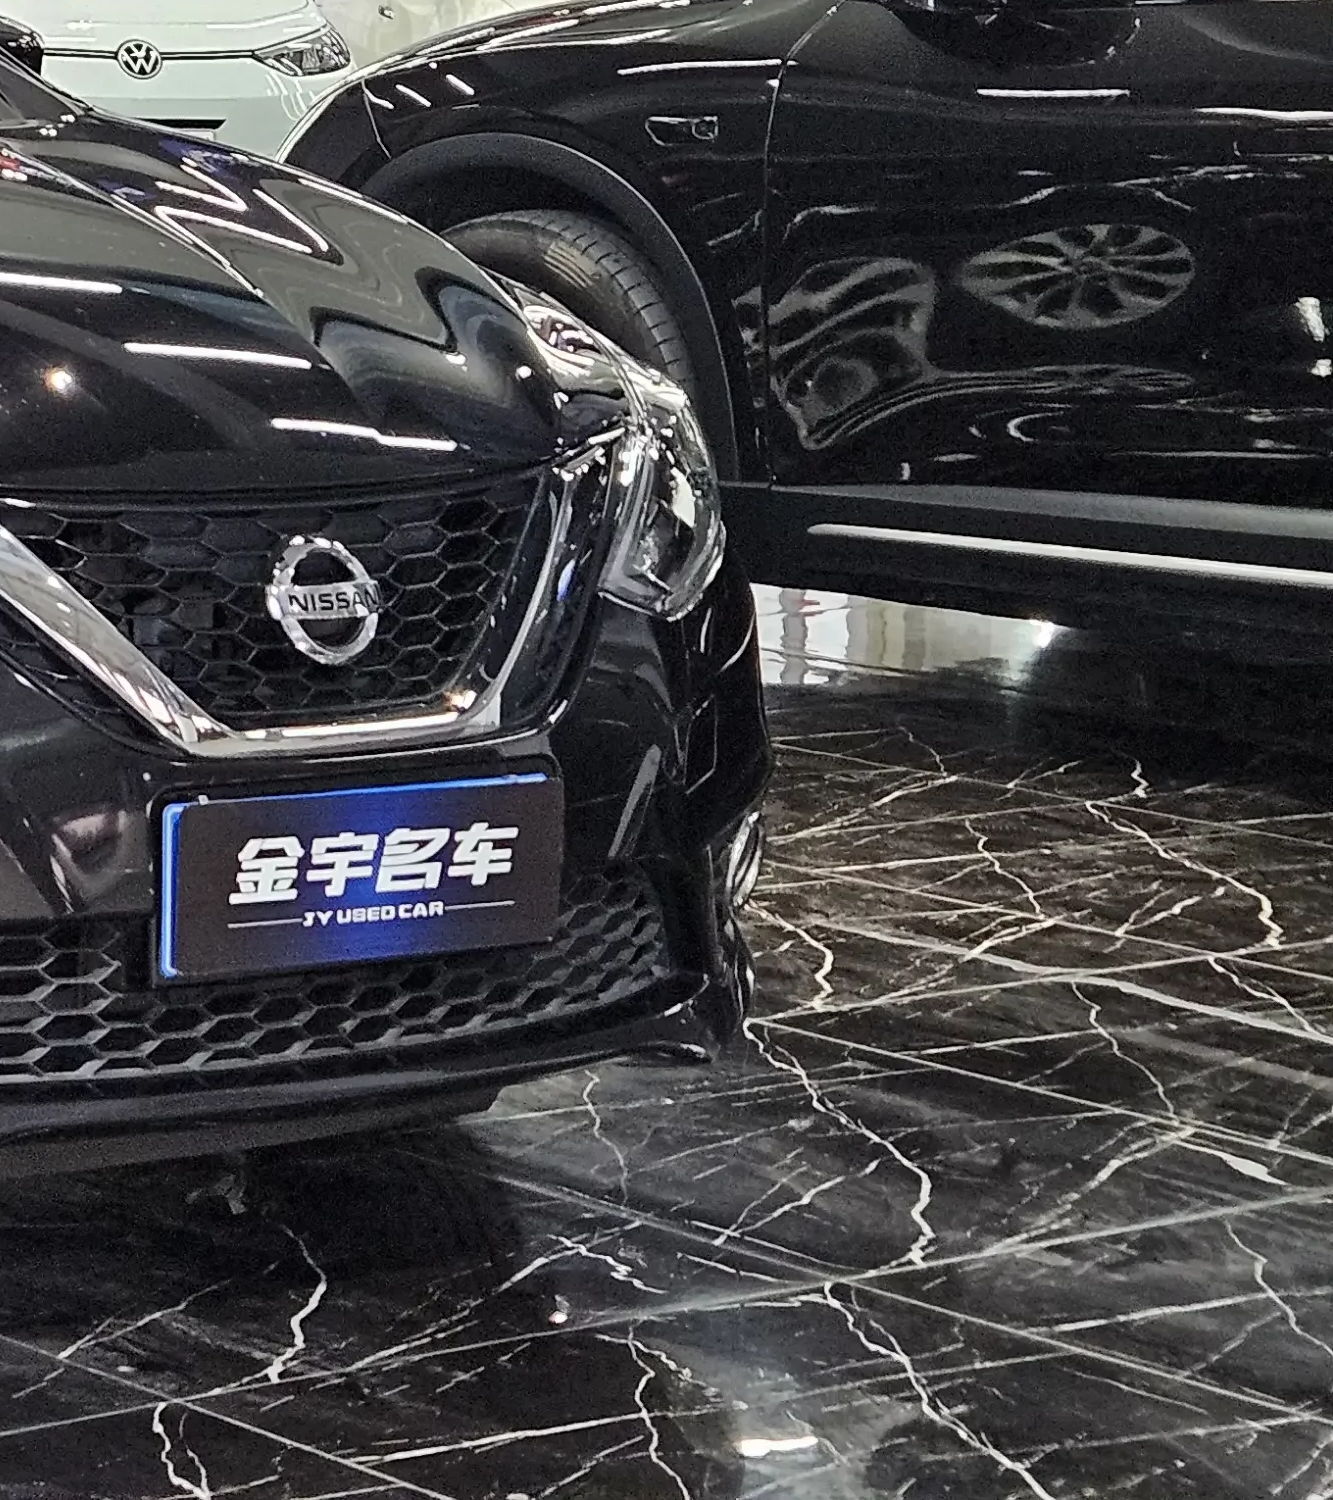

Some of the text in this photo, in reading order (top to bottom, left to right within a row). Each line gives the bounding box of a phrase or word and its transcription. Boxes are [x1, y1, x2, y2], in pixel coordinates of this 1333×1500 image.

[287, 580, 381, 613] NISSAN
[228, 822, 519, 905] 金宇名车
[301, 901, 445, 927] JY USED CAR
